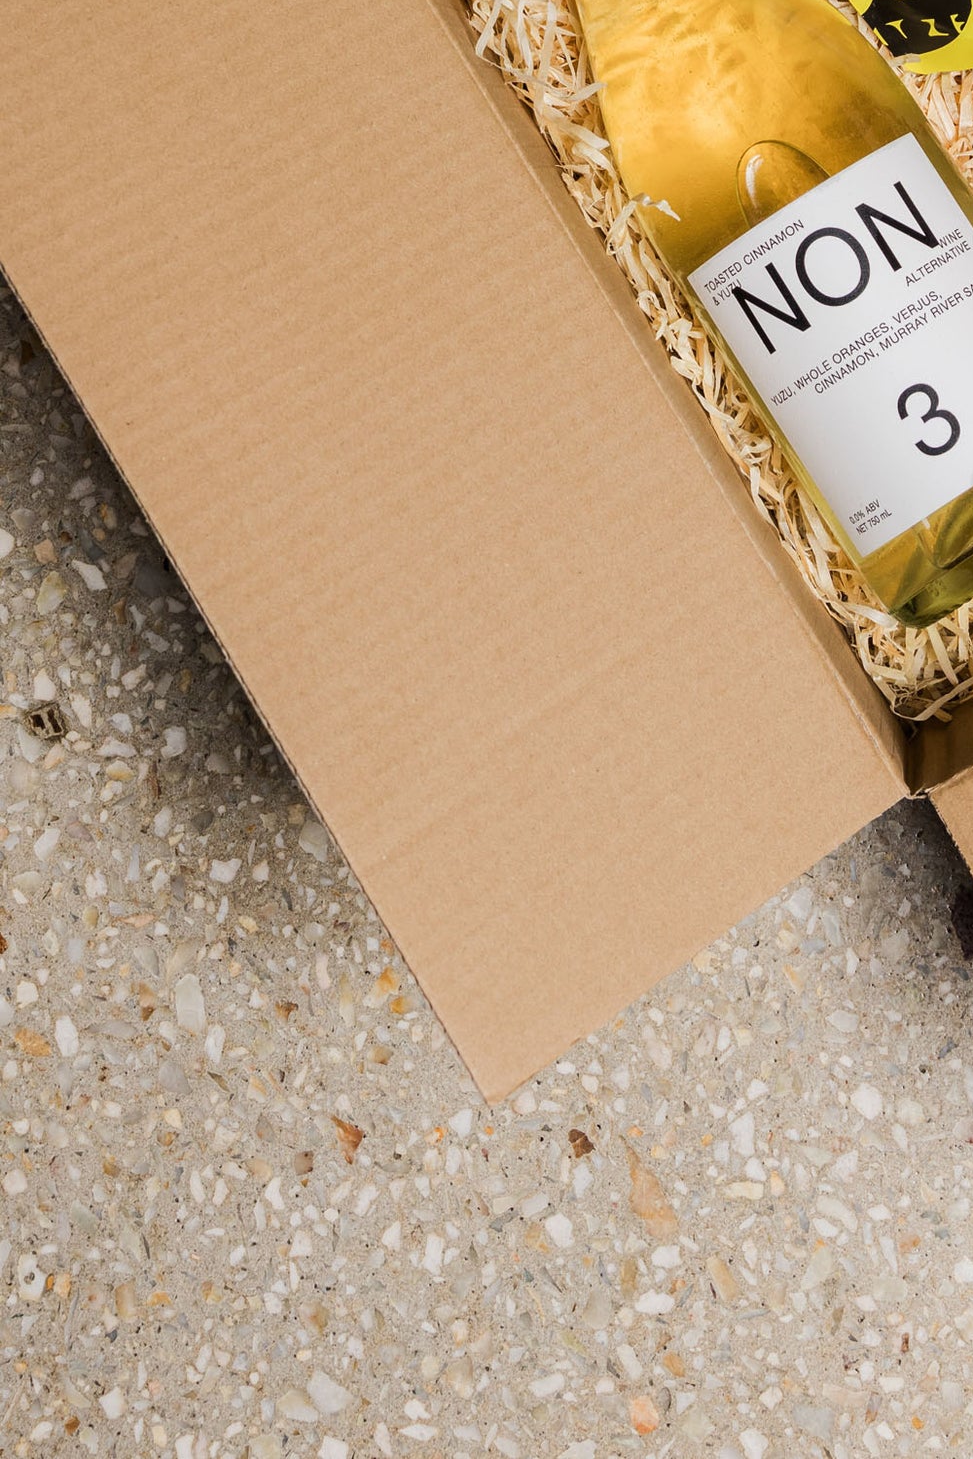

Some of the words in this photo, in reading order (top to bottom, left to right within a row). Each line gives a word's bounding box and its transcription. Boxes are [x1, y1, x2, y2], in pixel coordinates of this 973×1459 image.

[704, 262, 743, 293] TOASTED
[743, 219, 804, 266] CINNAMON
[732, 181, 940, 355] NON
[905, 240, 971, 287] ALTERNATIVE
[938, 228, 963, 248] WINE
[713, 296, 720, 306] &
[771, 387, 796, 407] YUZU,
[794, 360, 833, 389] WHOLE
[832, 322, 894, 364] ORANGES,
[892, 290, 943, 324] VERJUS,
[814, 348, 880, 394] CINNAMON,
[880, 313, 928, 351] MURRAY
[930, 292, 964, 318] RIVER
[897, 383, 962, 457] 3
[856, 522, 868, 535] NET
[867, 515, 881, 528] 750
[865, 499, 880, 515] ABV
